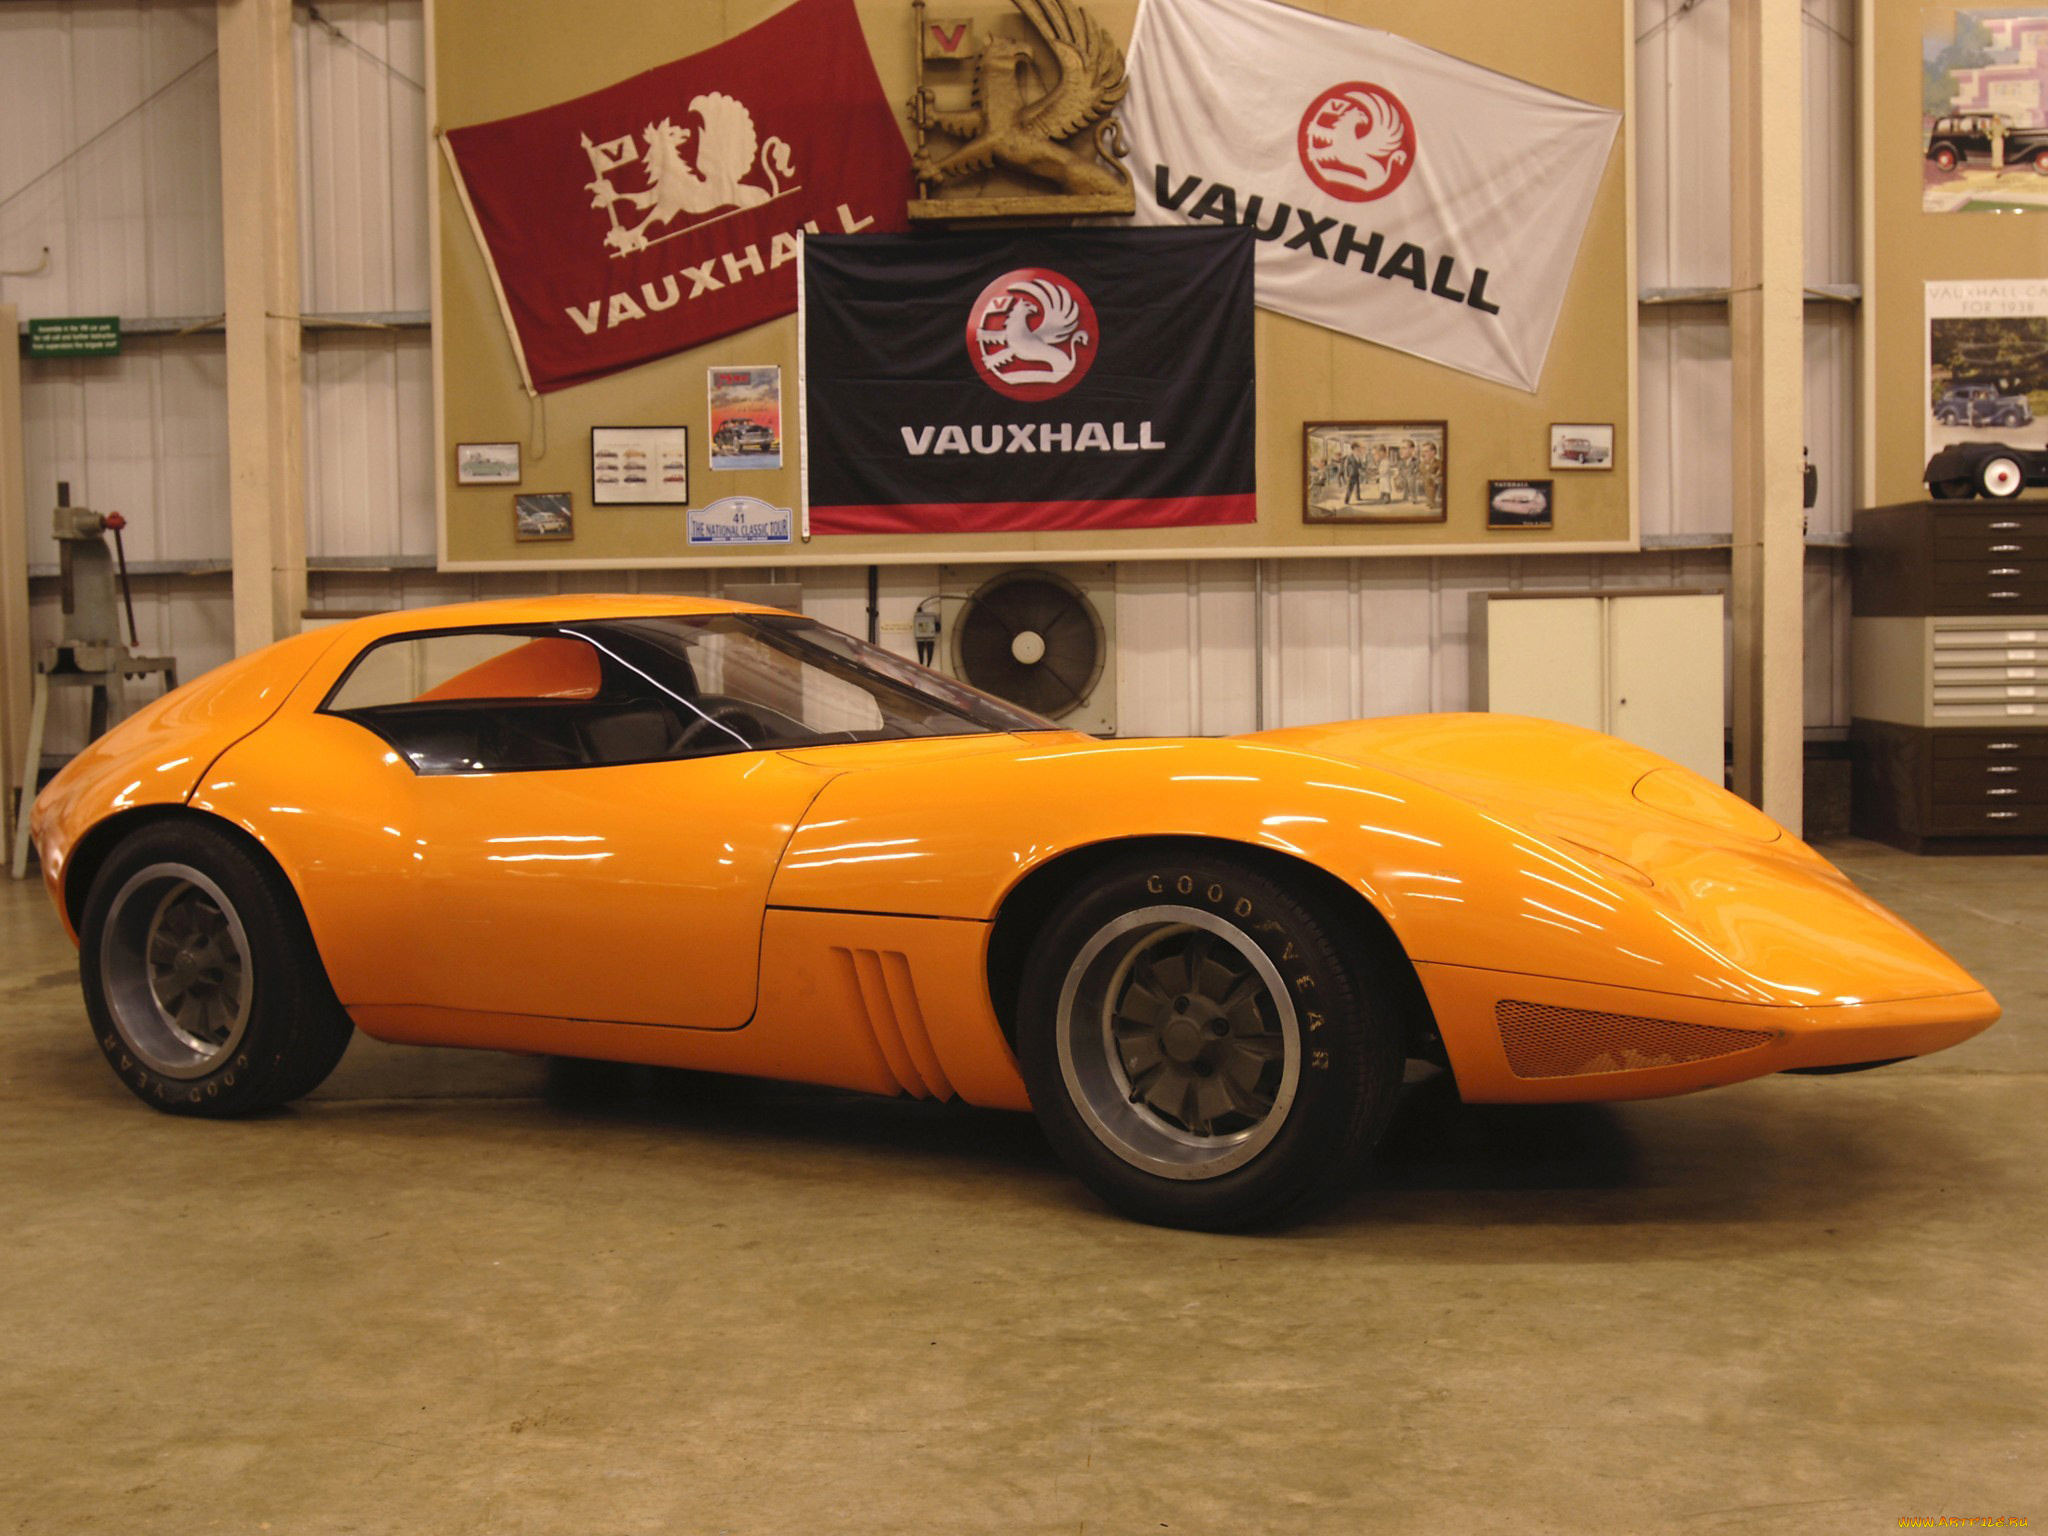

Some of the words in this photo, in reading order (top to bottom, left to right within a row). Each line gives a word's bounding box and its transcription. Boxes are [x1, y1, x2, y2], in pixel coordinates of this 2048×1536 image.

[930, 24, 967, 52] V
[600, 142, 624, 162] V
[1155, 164, 1500, 315] VAUXHALL
[565, 203, 875, 335] VAUXHAL
[1929, 285, 2017, 299] VAUXHALL
[1962, 300, 1992, 313] FOR
[901, 421, 1166, 455] VAUXHALL
[692, 520, 704, 536] THE
[706, 524, 740, 537] NATIONAL
[741, 523, 768, 536] CLASSIC
[770, 519, 788, 535] TOUR
[733, 513, 745, 523] 41
